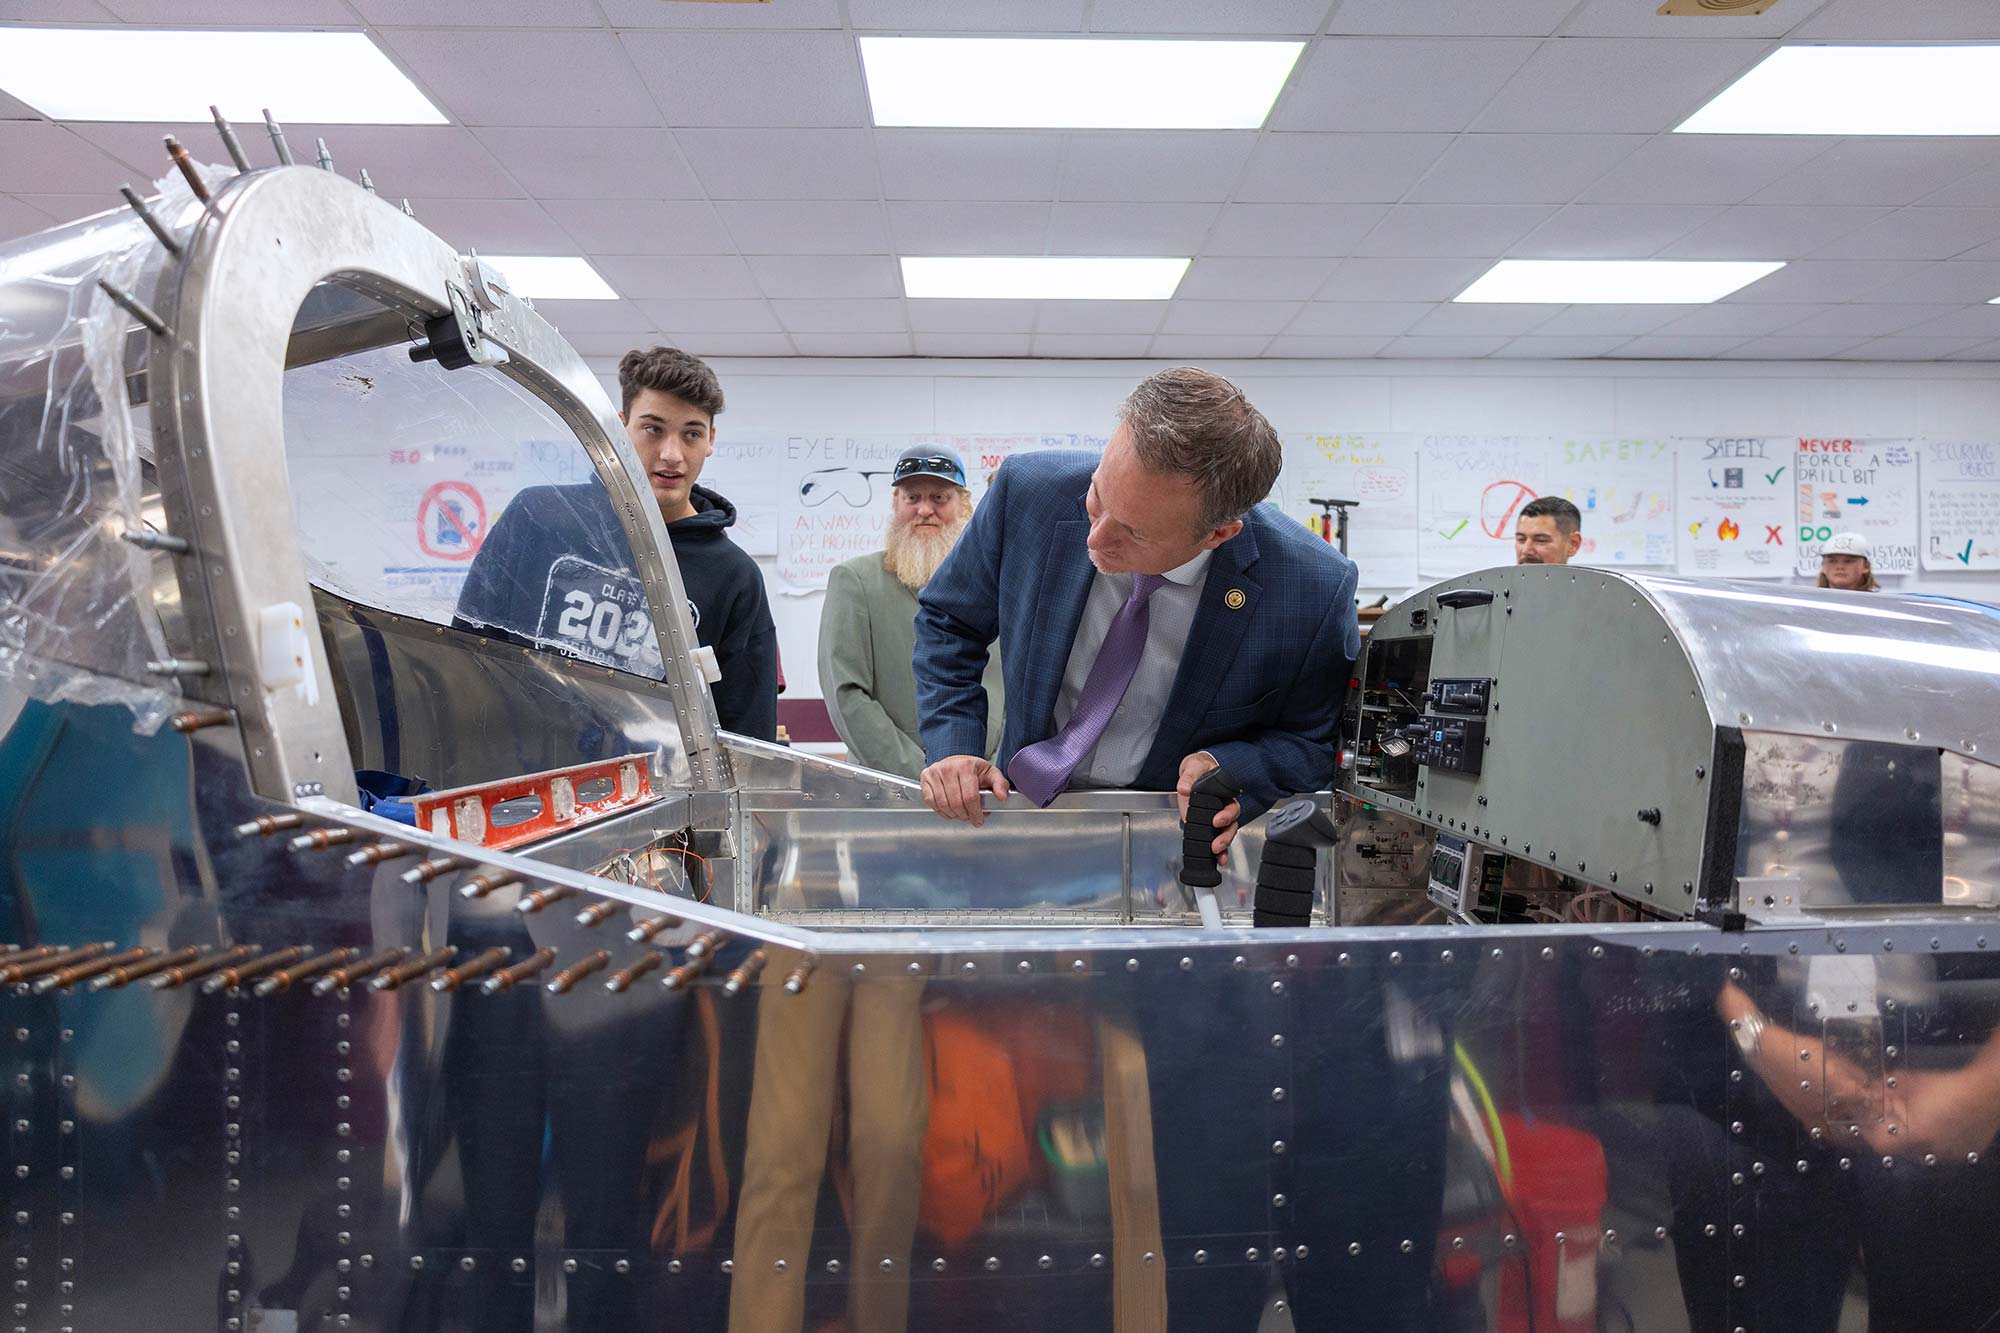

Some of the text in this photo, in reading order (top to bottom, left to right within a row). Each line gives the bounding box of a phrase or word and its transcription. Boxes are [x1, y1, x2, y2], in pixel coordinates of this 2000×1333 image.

[787, 437, 835, 459] EYE
[1563, 440, 1665, 464] SAFETY
[1705, 438, 1765, 457] SAFETY
[1798, 454, 1852, 467] FORCE
[1870, 454, 1880, 467] A
[1798, 469, 1876, 485] DRILL BIT
[1800, 526, 1832, 542] DO
